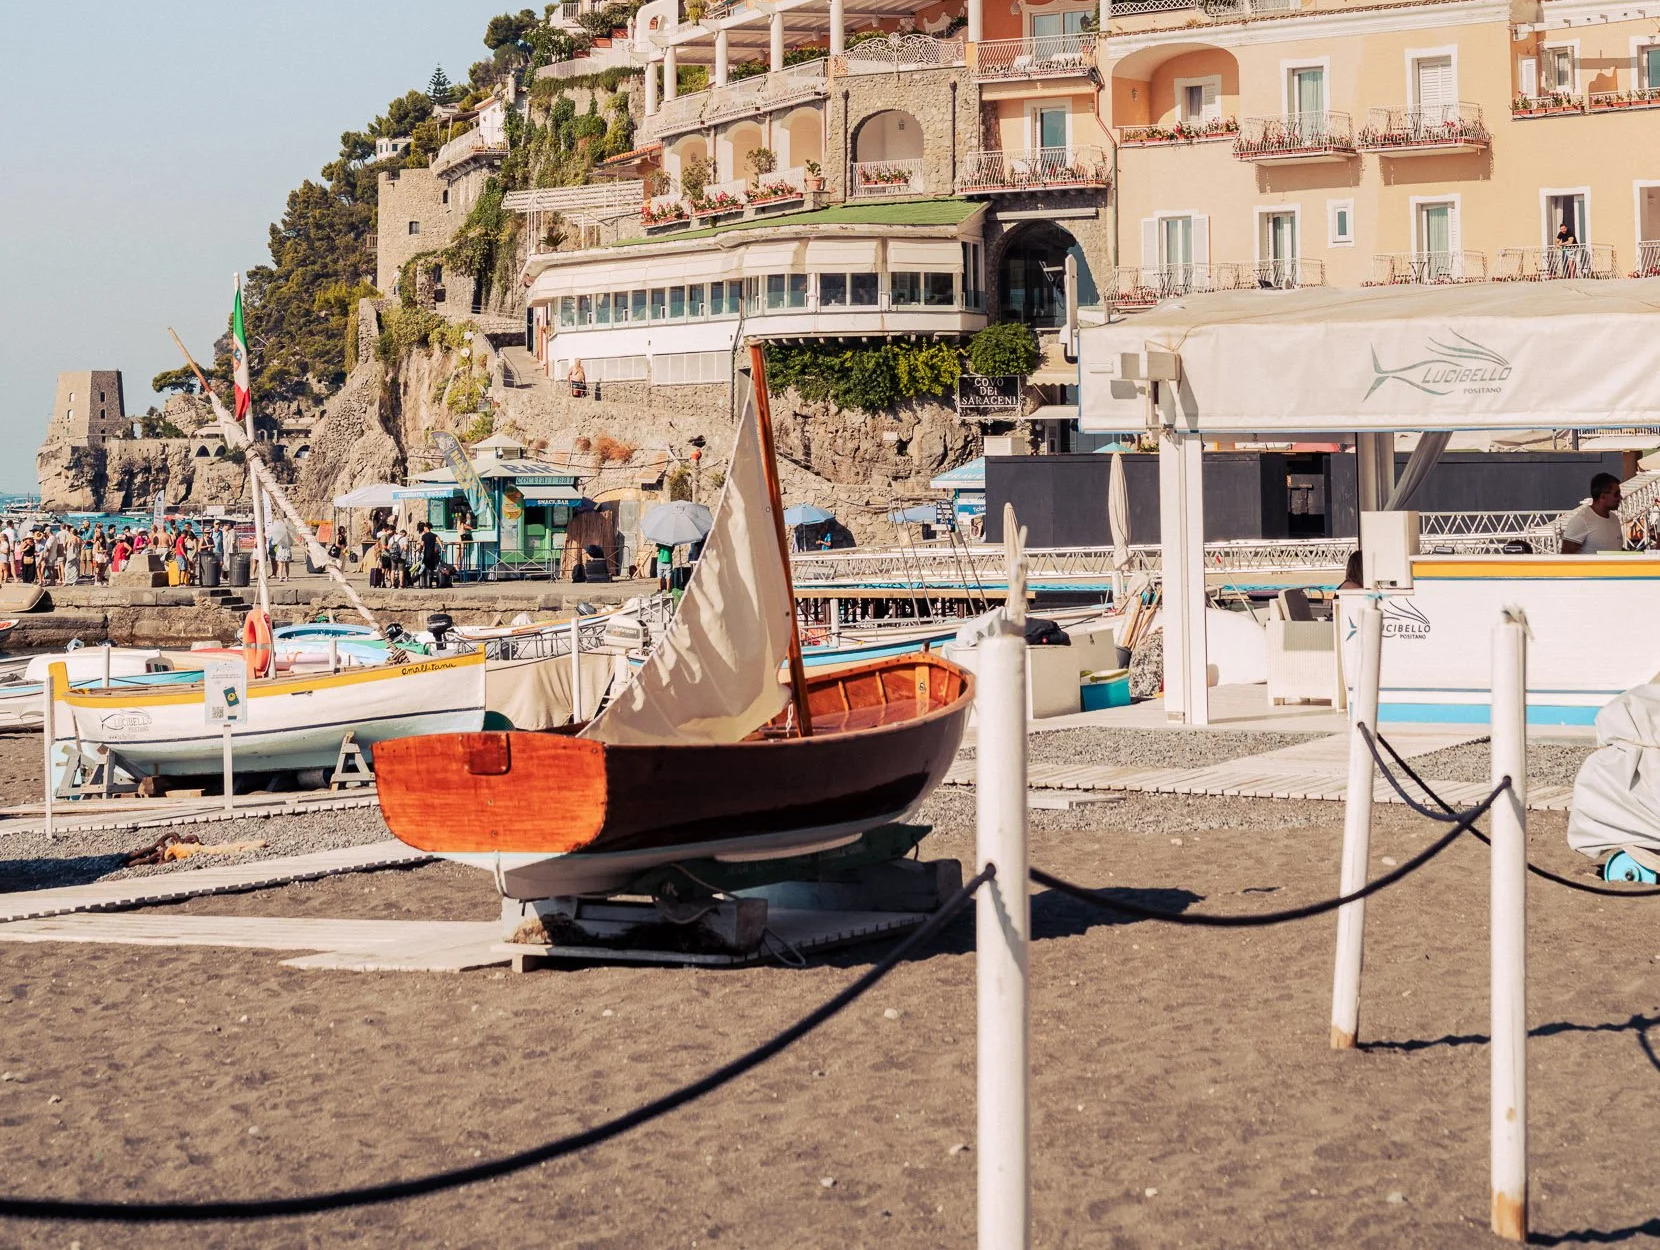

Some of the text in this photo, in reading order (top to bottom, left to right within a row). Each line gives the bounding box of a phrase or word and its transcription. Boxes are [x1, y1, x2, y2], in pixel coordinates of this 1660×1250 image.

[1421, 367, 1512, 384] LUCIBELLO
[974, 378, 1004, 387] COVO
[1463, 387, 1502, 395] POSITANO
[961, 396, 1016, 405] SARACENI
[500, 464, 564, 474] BAR
[1382, 624, 1431, 633] CIBELLO
